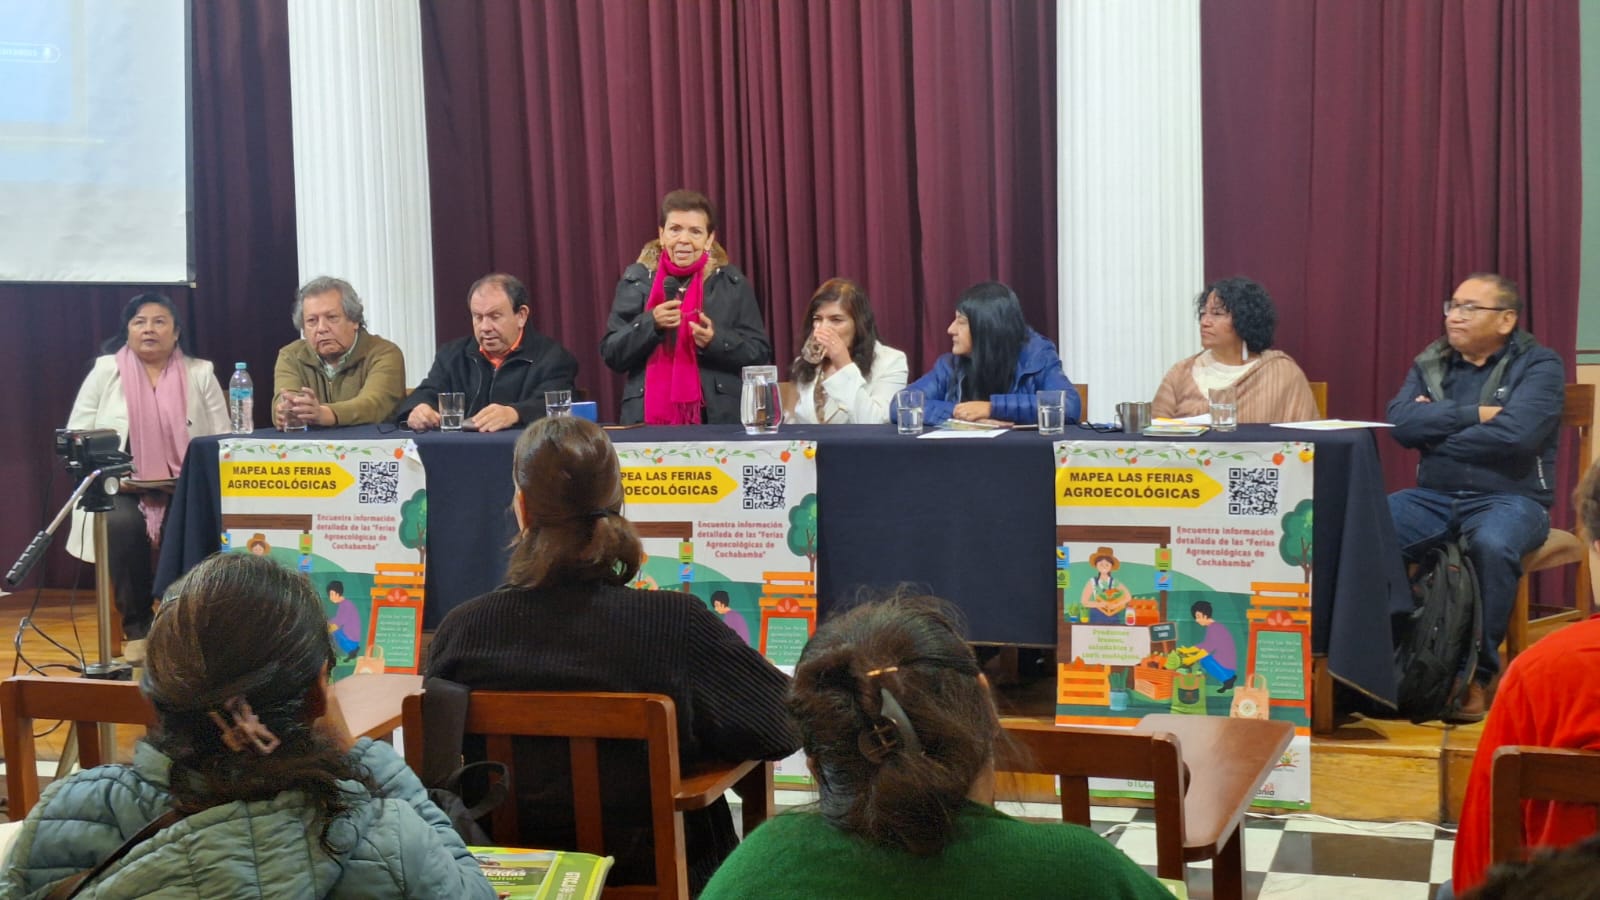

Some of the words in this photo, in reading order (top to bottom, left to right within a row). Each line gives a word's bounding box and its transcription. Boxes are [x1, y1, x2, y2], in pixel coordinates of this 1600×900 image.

[233, 466, 267, 475] MAPEA
[271, 467, 290, 475] LAS
[294, 467, 331, 475] FERIAS
[620, 471, 642, 481] PEA
[646, 471, 667, 481] LAS
[671, 471, 712, 481] FERIAS
[1070, 472, 1114, 482] MAPEA
[1118, 472, 1143, 482] LAS
[1147, 473, 1193, 483] FERIAS
[228, 478, 336, 490] AGROECOLÓGICAS
[624, 483, 718, 496] OECOLÓGICAS
[1064, 486, 1200, 499] AGROECOLÓGICAS
[1177, 526, 1220, 534] Encuentra
[1222, 527, 1275, 536] información
[1176, 537, 1216, 545] detallada
[1219, 537, 1229, 545] de
[1232, 538, 1244, 546] las
